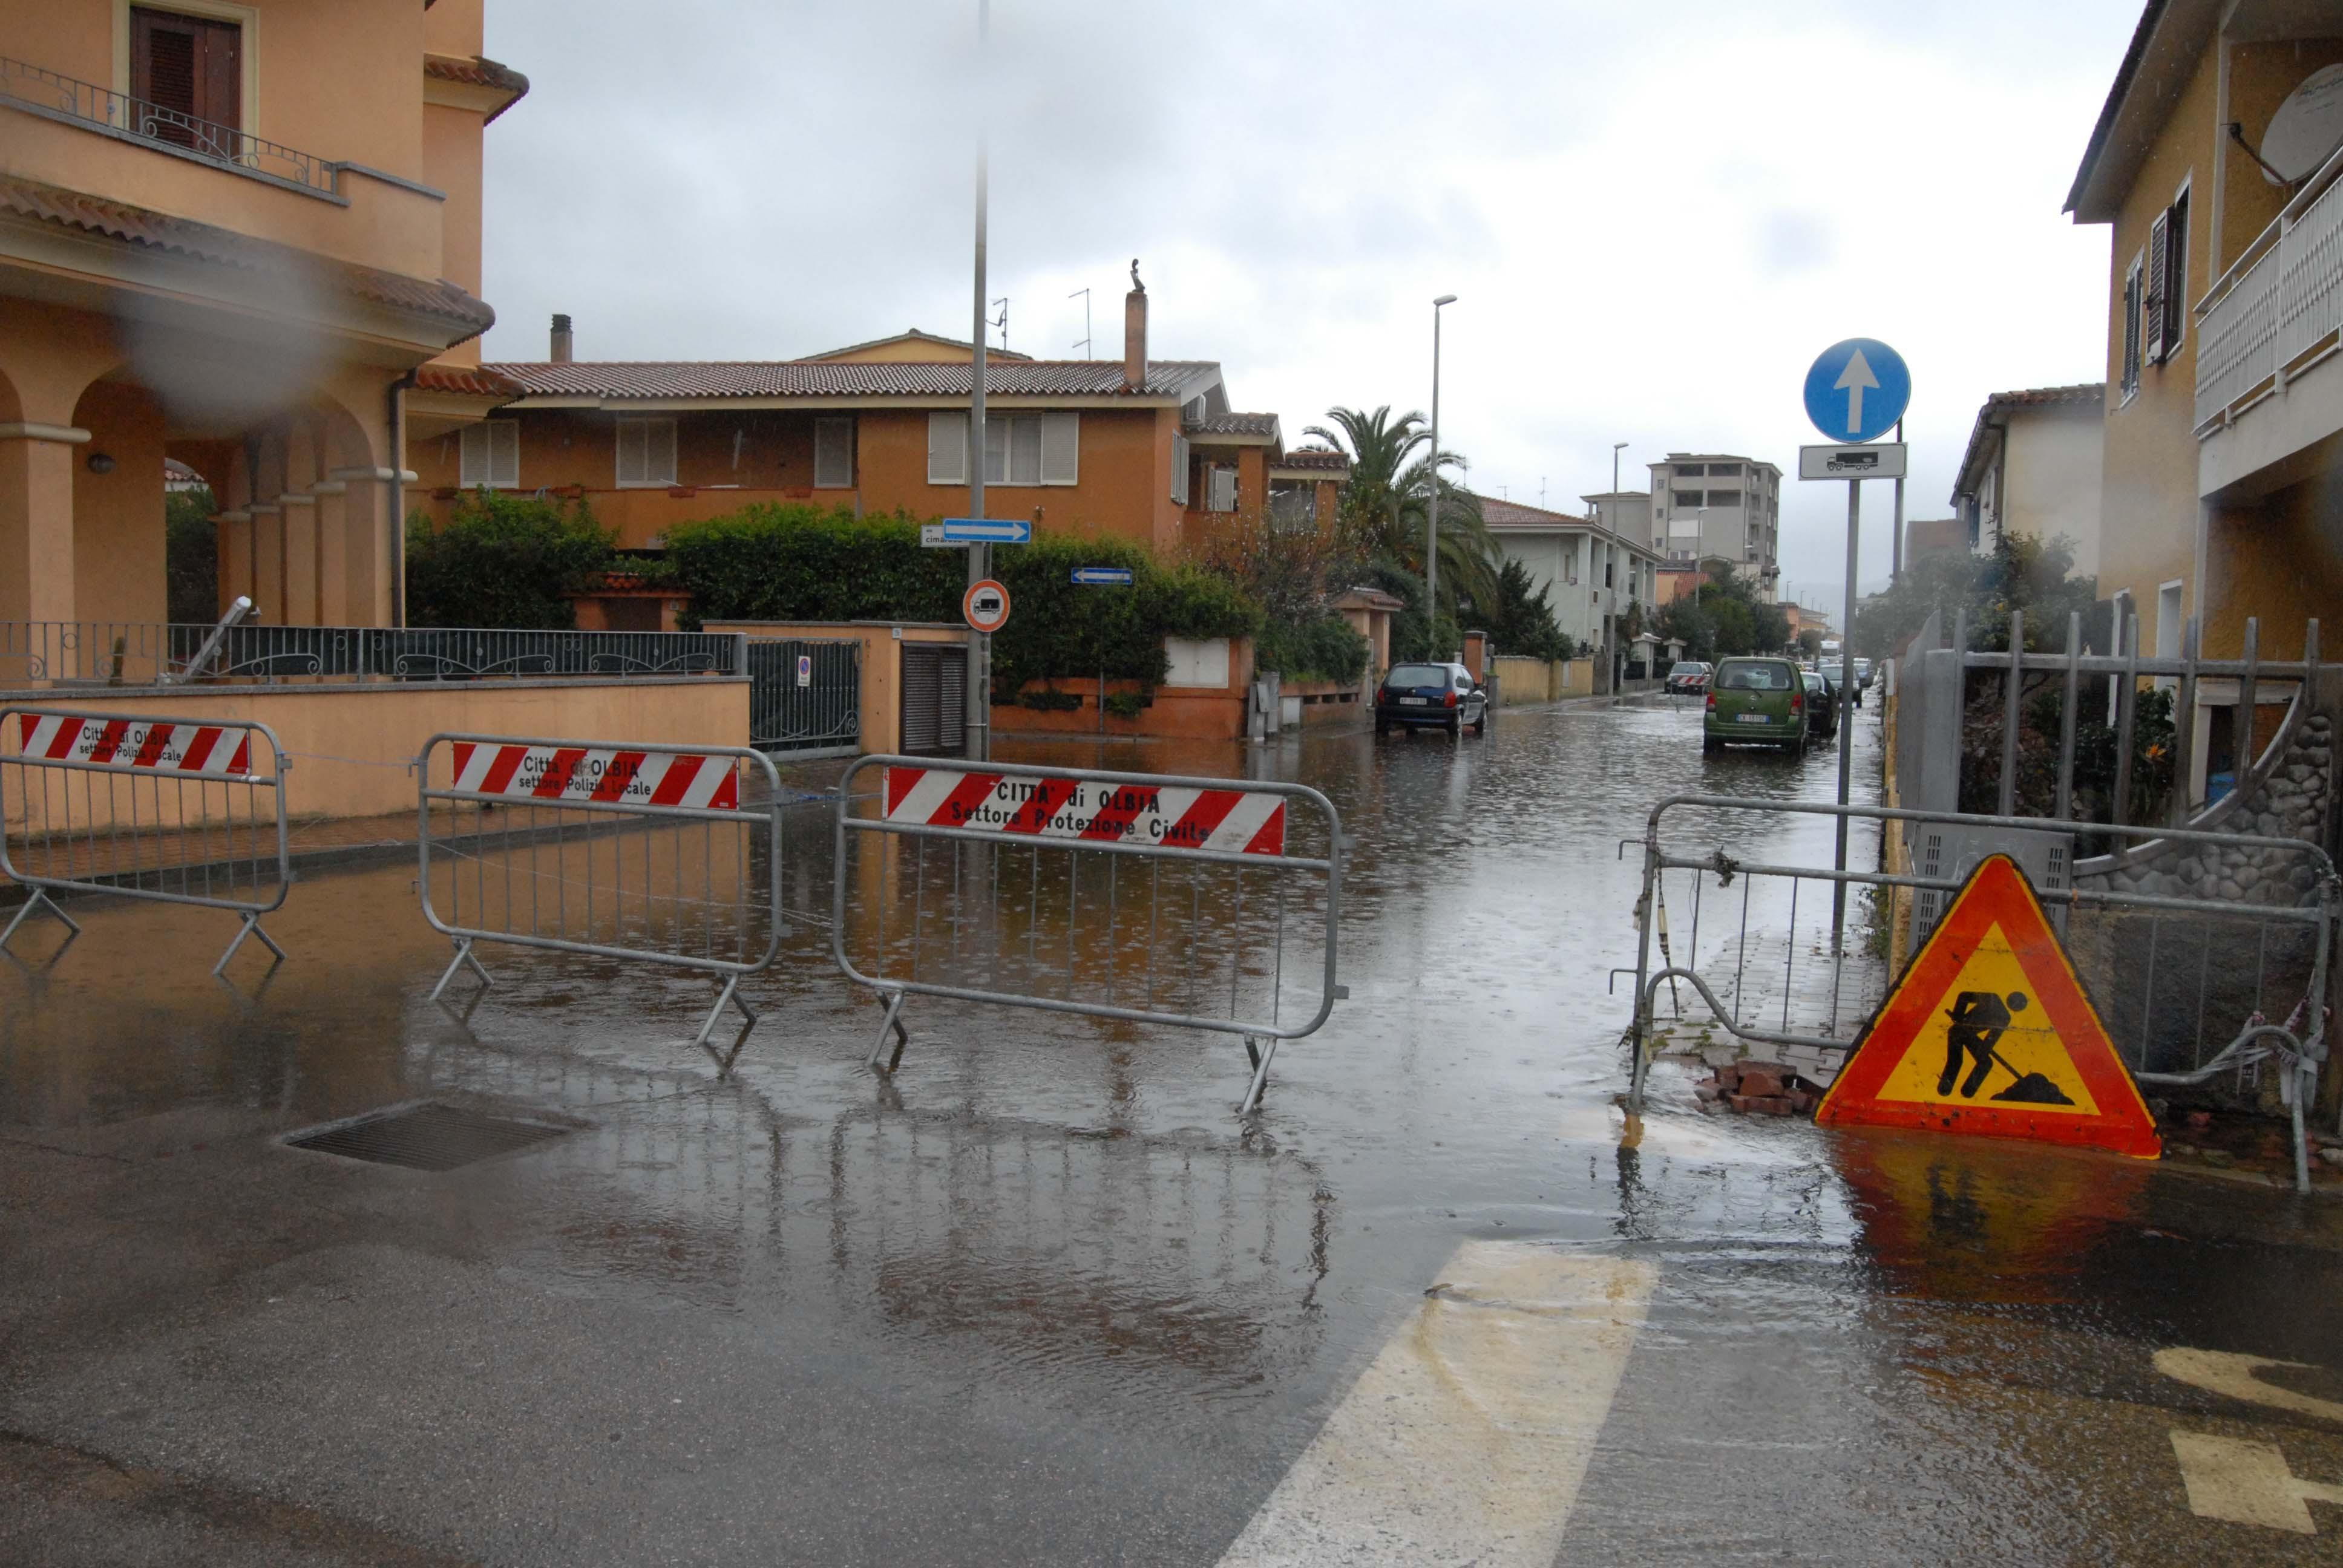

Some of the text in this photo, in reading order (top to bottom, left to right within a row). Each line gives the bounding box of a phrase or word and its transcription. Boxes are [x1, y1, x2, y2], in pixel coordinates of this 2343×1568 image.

[119, 730, 129, 743] di
[134, 730, 172, 746] OLBIA
[116, 745, 146, 759] Polizia
[591, 759, 639, 778] OLBIA
[519, 777, 651, 795] settore Polizia Locale
[997, 782, 1161, 814] CITTA' di OLBIA
[951, 802, 1210, 842] Settore Protezione Civile
